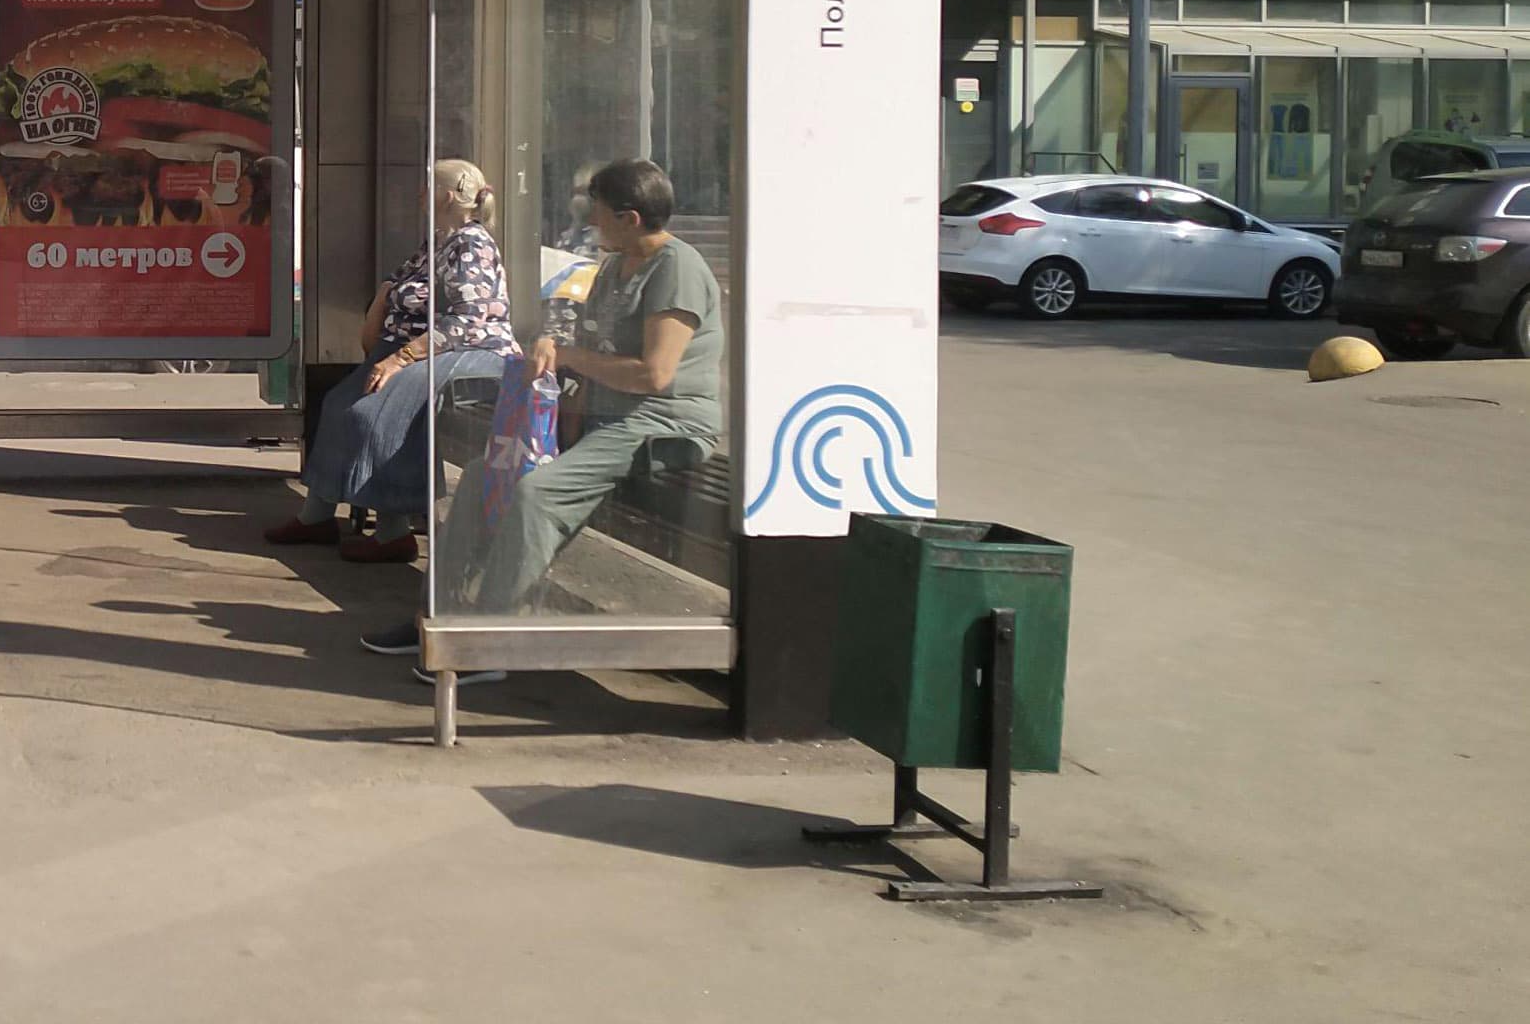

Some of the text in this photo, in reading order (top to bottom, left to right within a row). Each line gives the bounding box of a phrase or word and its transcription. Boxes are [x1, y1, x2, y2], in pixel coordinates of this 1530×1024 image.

[26, 71, 96, 117] 100% ГОВЯДИНА
[24, 117, 98, 139] НА ОГНЕ
[27, 242, 193, 274] 60 метров
